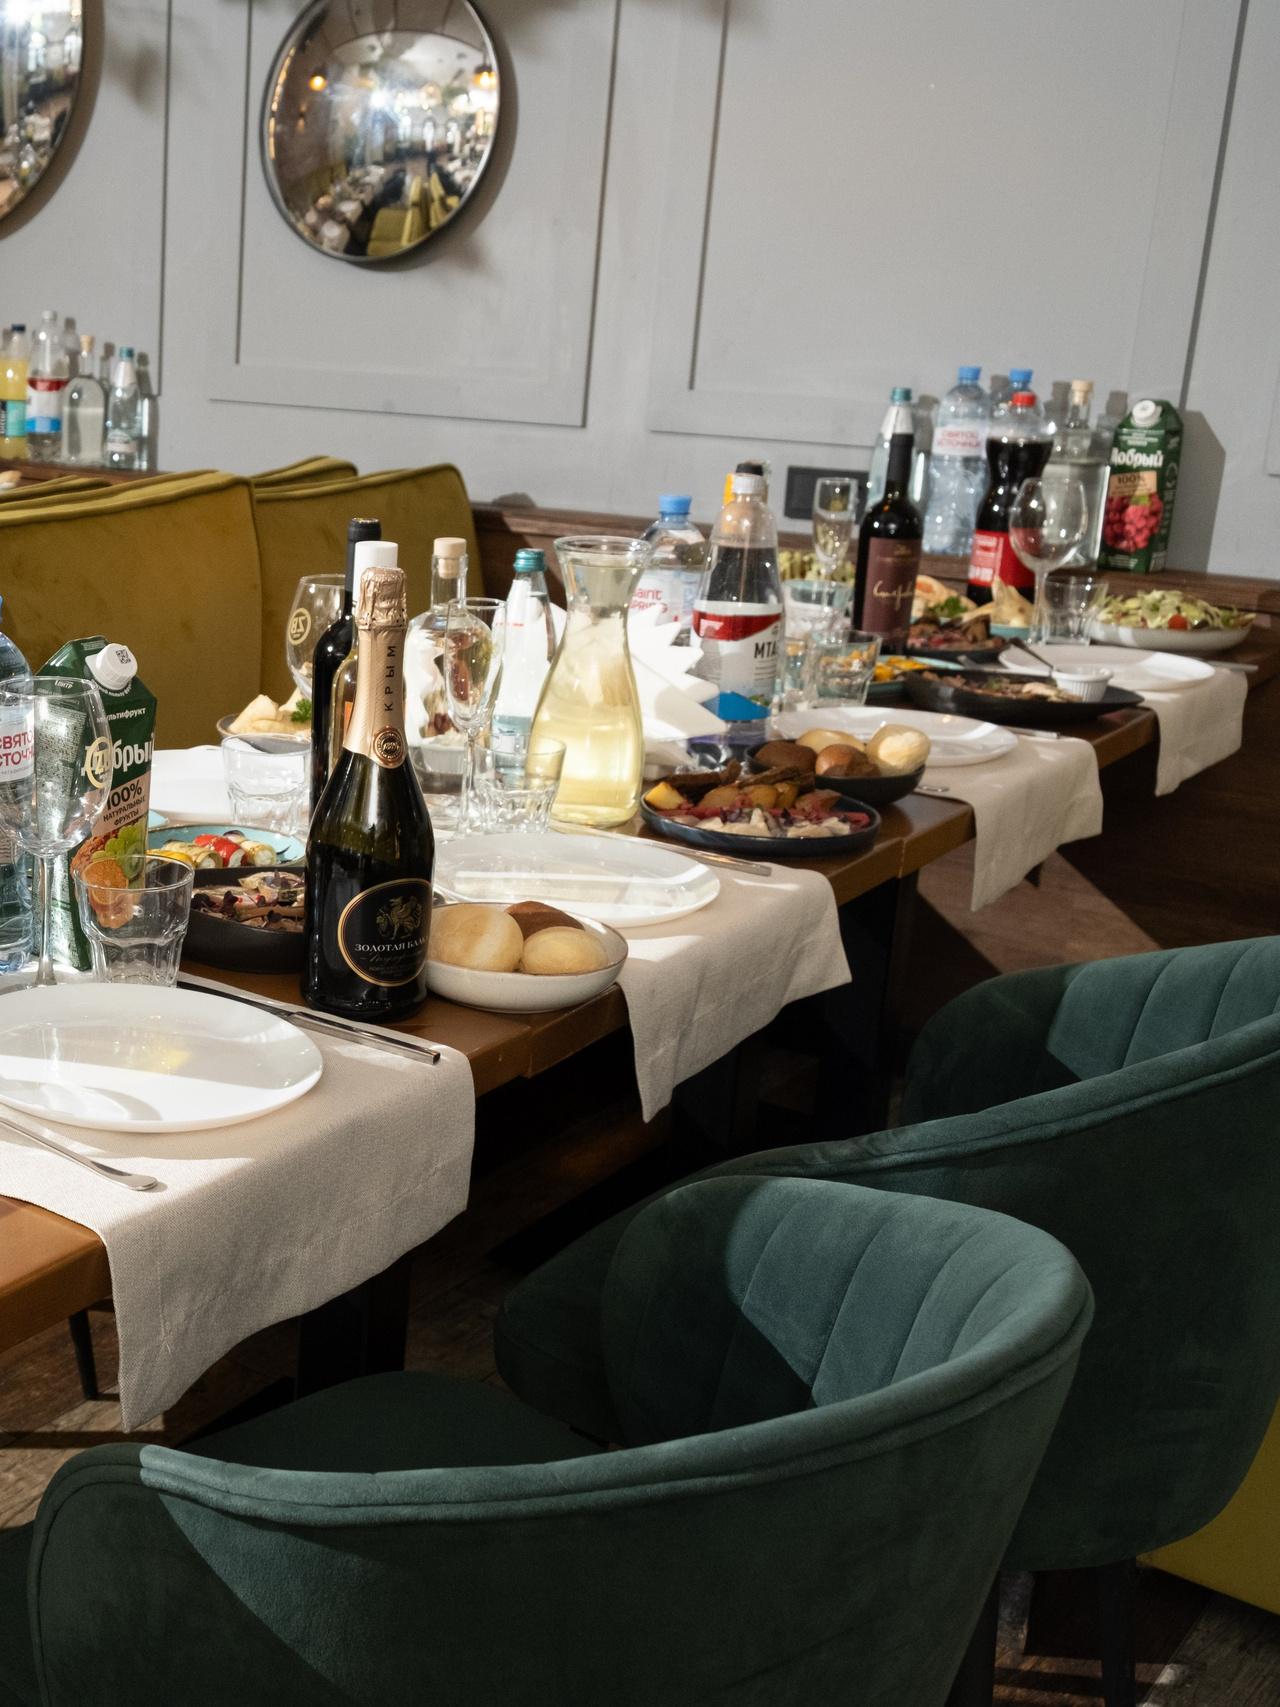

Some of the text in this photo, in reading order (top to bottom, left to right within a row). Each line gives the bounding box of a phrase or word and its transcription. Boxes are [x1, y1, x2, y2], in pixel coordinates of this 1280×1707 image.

[384, 645, 396, 712] КРЫМ
[107, 779, 142, 810] 100%
[103, 795, 146, 822] НАТУРАЛЬНЫЕ
[114, 809, 139, 825] ФРУКТЫ
[355, 935, 429, 952] ЗОЛОТАЯ БАЛК
